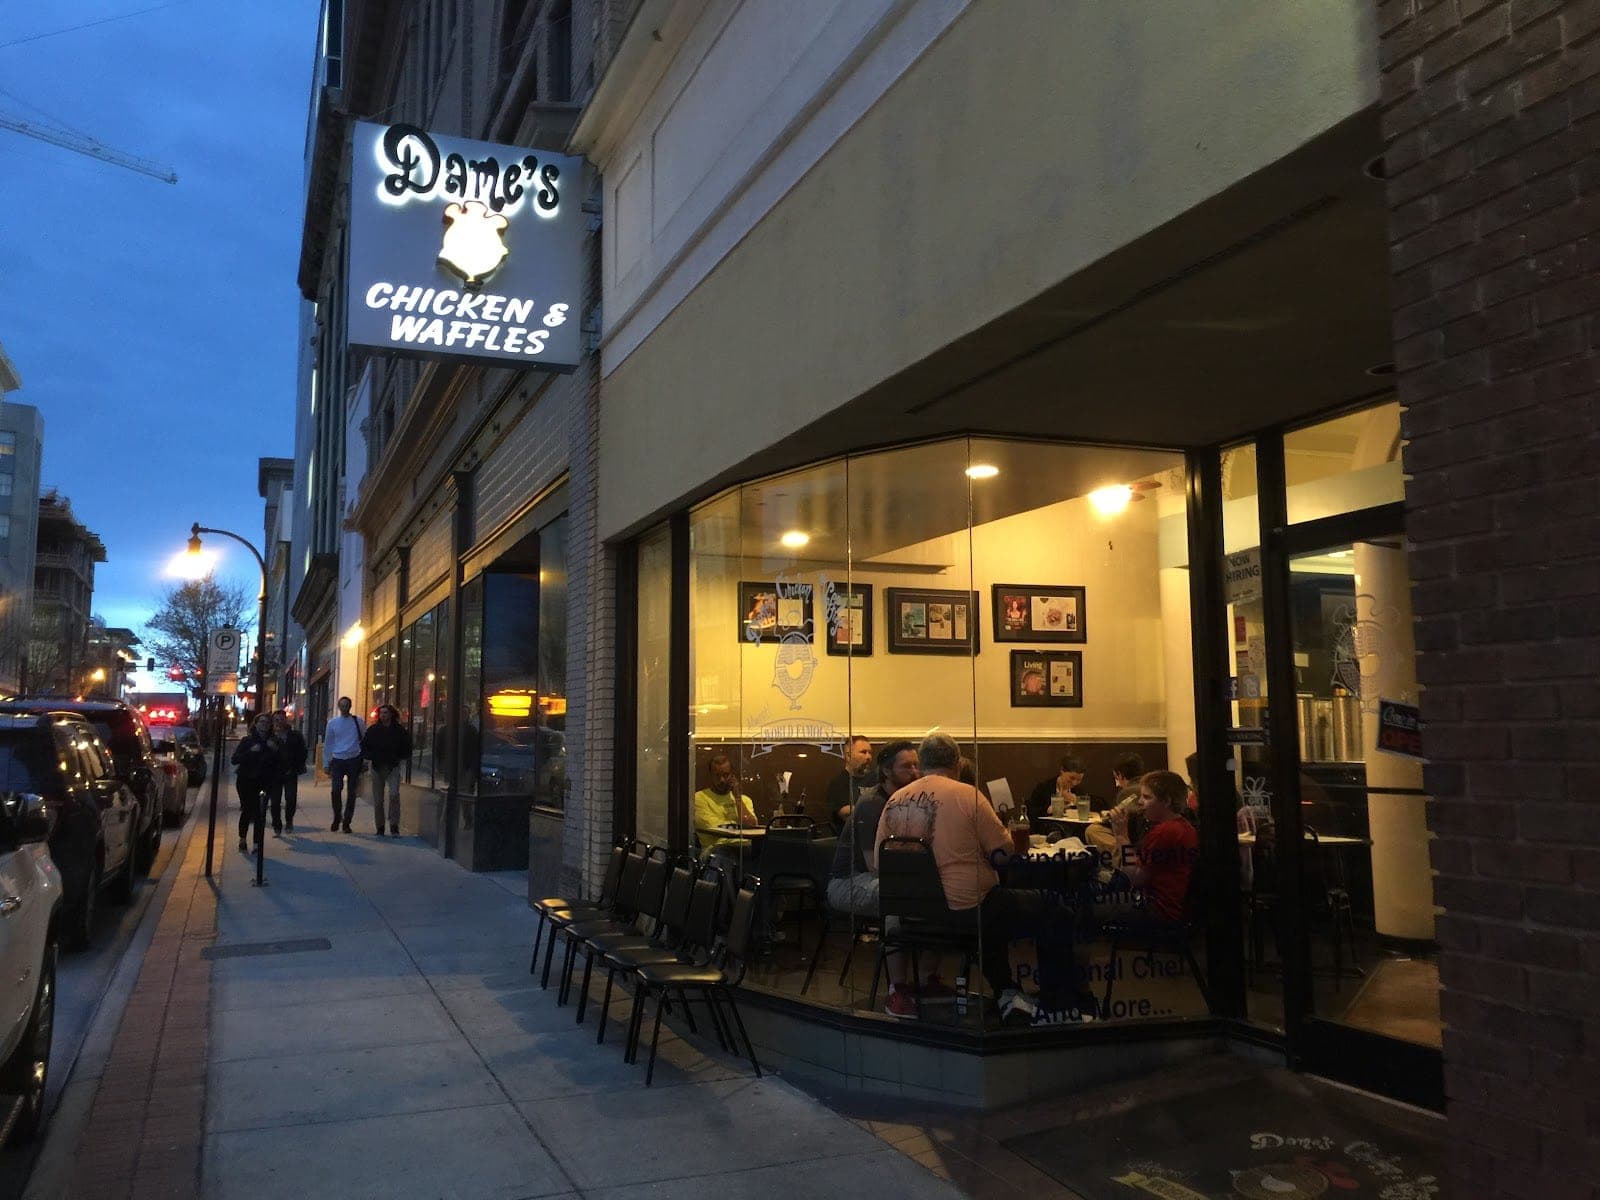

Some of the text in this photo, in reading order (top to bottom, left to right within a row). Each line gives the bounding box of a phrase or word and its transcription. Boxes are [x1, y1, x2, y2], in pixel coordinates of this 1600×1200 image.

[383, 122, 559, 212] Dame's
[365, 282, 569, 327] CHICKEN &
[390, 315, 550, 355] WAFFLES
[1225, 565, 1260, 583] HIRING
[1228, 554, 1250, 567] NOW
[220, 635, 231, 647] P
